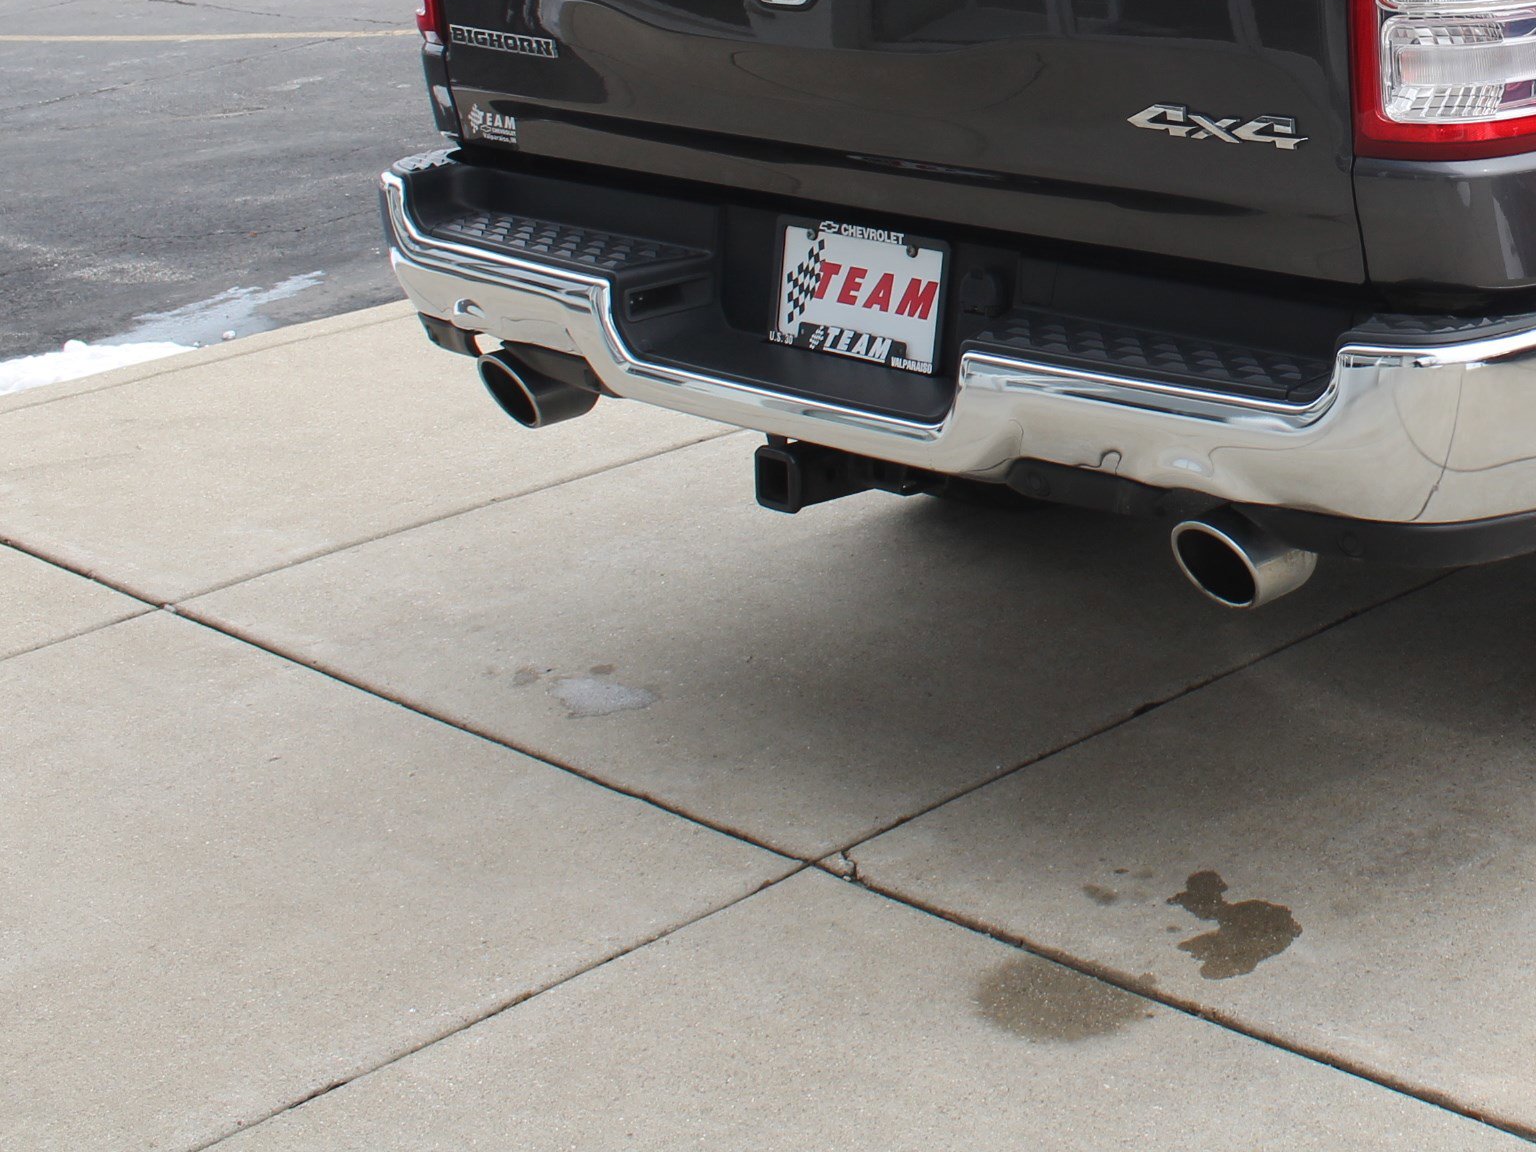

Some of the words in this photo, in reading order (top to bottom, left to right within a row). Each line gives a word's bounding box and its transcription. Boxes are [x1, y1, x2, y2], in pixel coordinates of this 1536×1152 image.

[450, 24, 558, 59] BIGHORN
[478, 111, 516, 130] TEAM
[840, 223, 905, 245] CHEVROLET
[813, 261, 939, 321] TEAM
[823, 326, 894, 361] TEAM
[891, 356, 933, 375] VALPARAISO
